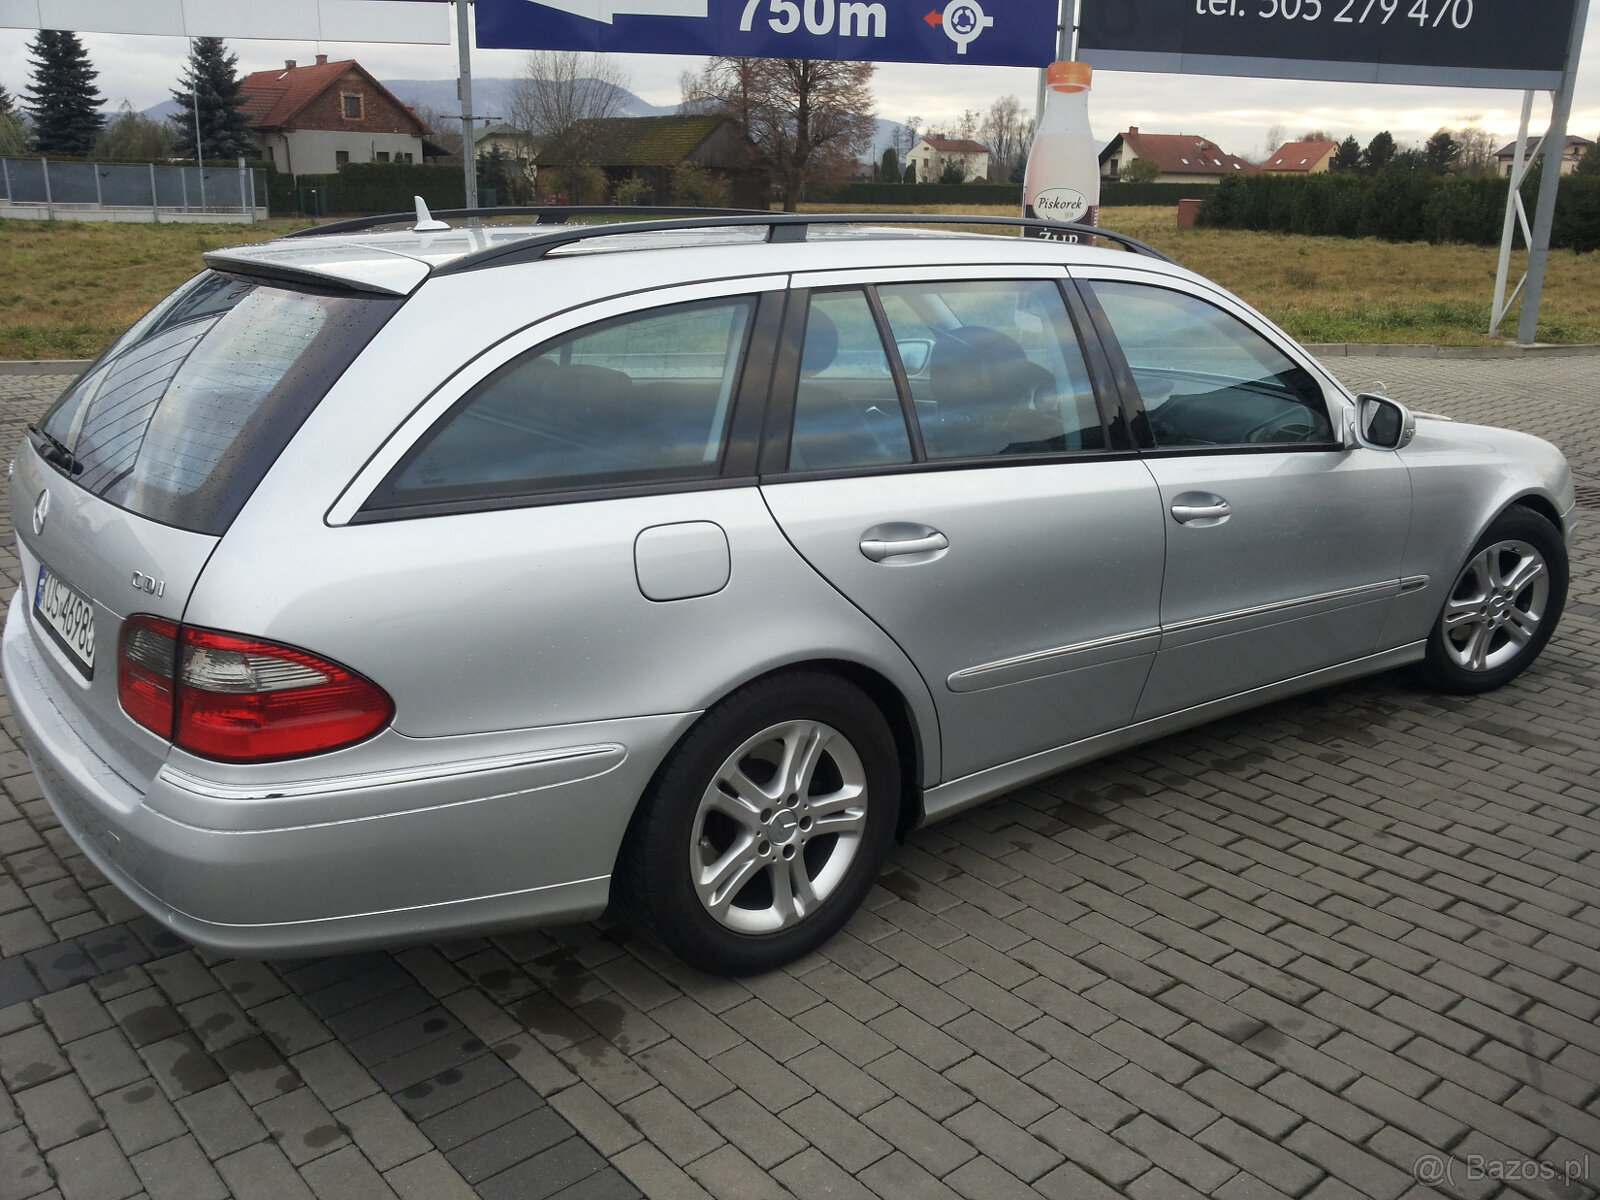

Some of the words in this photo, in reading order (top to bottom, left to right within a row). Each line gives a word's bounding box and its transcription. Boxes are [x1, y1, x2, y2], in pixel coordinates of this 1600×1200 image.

[740, 0, 887, 37] 750m
[1333, 0, 1398, 24] 279
[1407, 0, 1473, 29] 470
[1038, 196, 1082, 209] Piskorek
[132, 570, 165, 598] CDI
